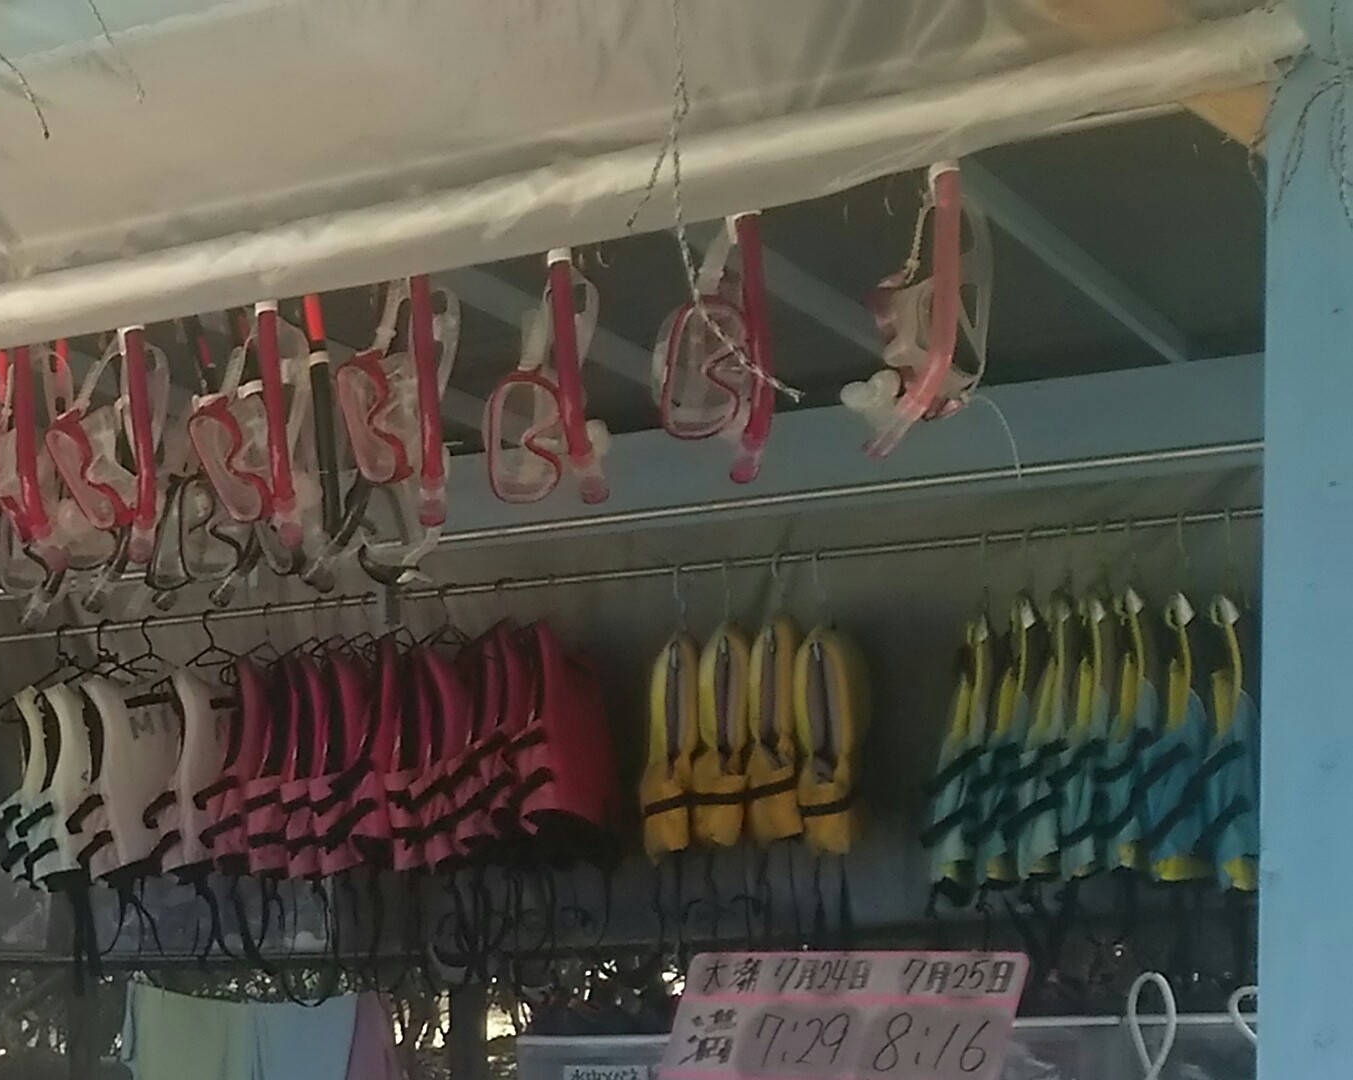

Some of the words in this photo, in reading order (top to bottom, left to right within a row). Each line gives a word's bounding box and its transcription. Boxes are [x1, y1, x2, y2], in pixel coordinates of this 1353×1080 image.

[774, 958, 872, 993] 7月24日
[902, 959, 1016, 995] 7月25日
[756, 1013, 849, 1068] 7:29
[872, 1012, 991, 1073] 8:16
